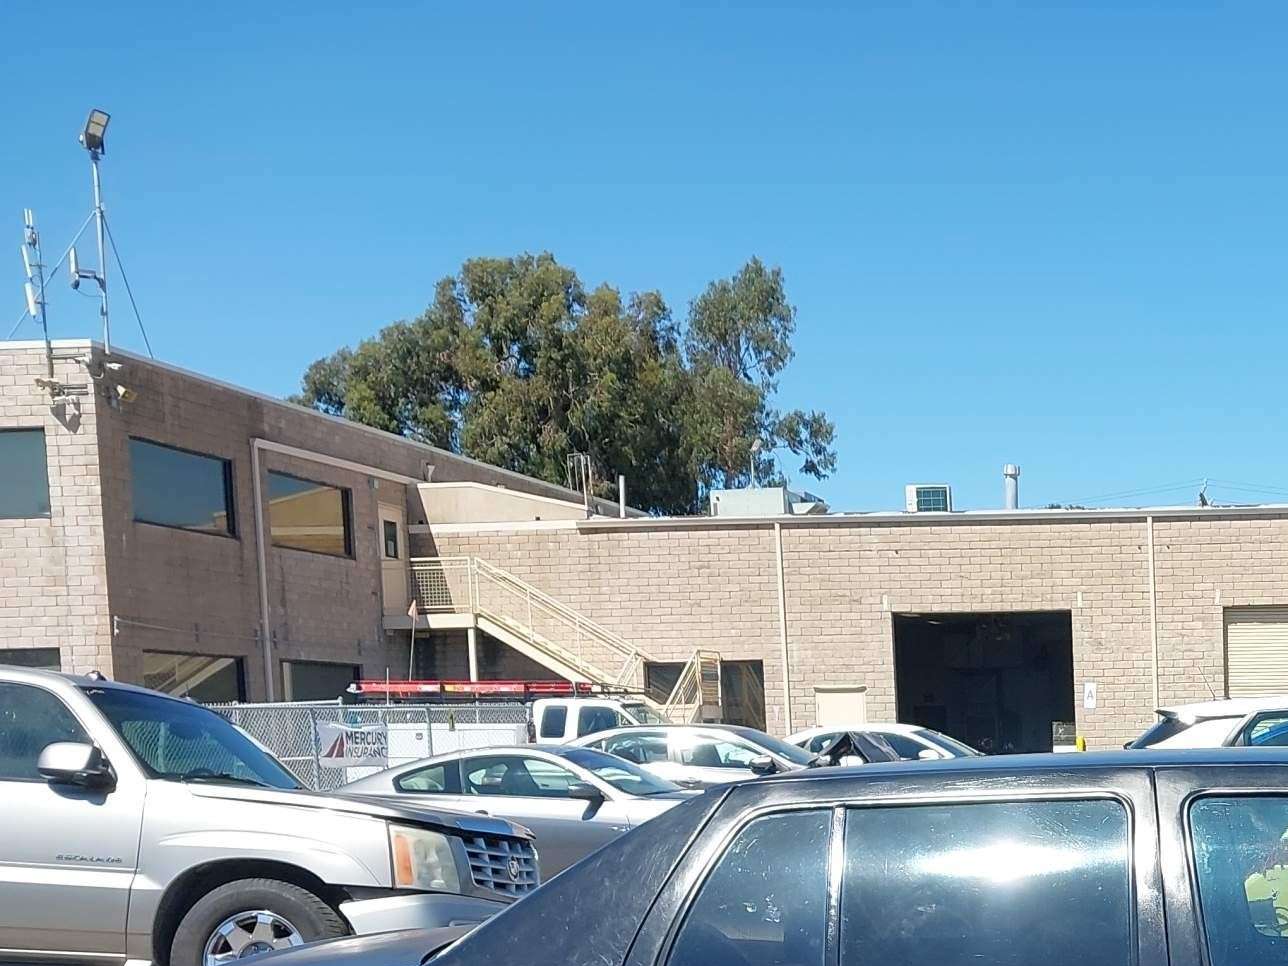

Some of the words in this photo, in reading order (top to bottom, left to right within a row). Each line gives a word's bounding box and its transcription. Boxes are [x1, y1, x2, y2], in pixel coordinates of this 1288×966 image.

[1086, 689, 1094, 699] A
[345, 731, 387, 746] MERCURY
[345, 746, 388, 758] INSURANC
